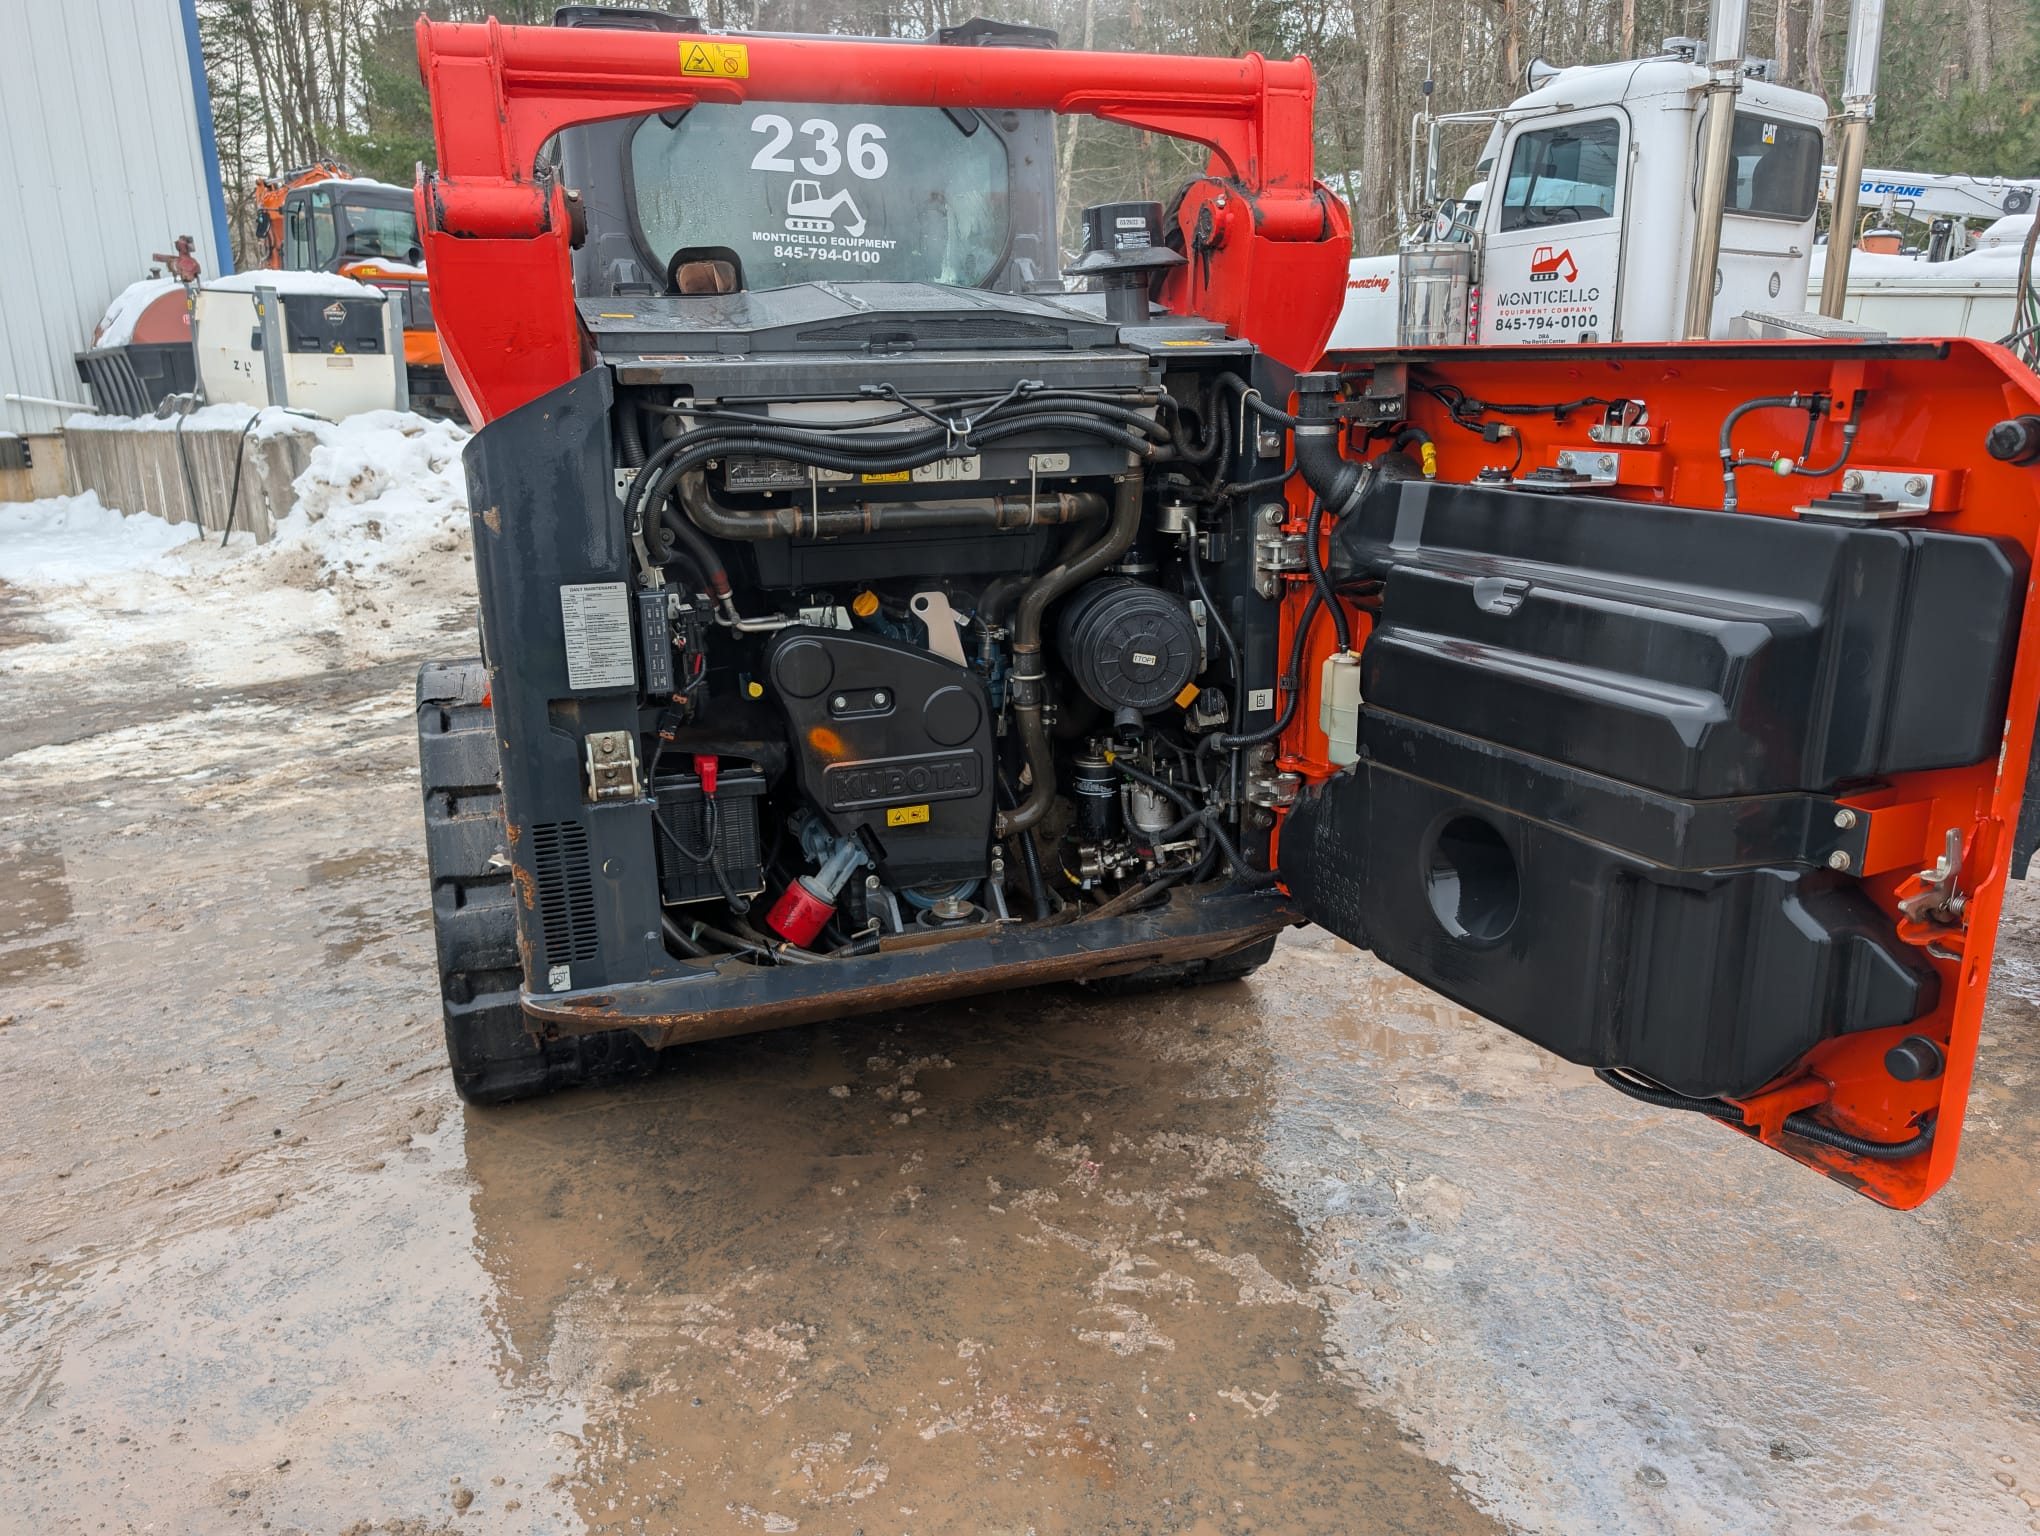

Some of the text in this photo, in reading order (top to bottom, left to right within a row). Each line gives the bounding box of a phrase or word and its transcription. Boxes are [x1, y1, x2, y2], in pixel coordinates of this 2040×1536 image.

[1762, 123, 1778, 144] CAT
[751, 114, 888, 180] 236
[1874, 184, 1926, 197] CRANE
[752, 231, 897, 250] MONTICELLO EQUIPMENT
[774, 245, 880, 264] 845-794-0100
[1497, 287, 1600, 307] MONTICELLO
[1500, 306, 1593, 316] EQUIPMENT COMPANY
[1495, 314, 1598, 331] 845-794-0100
[835, 762, 971, 800] KUBOTA
